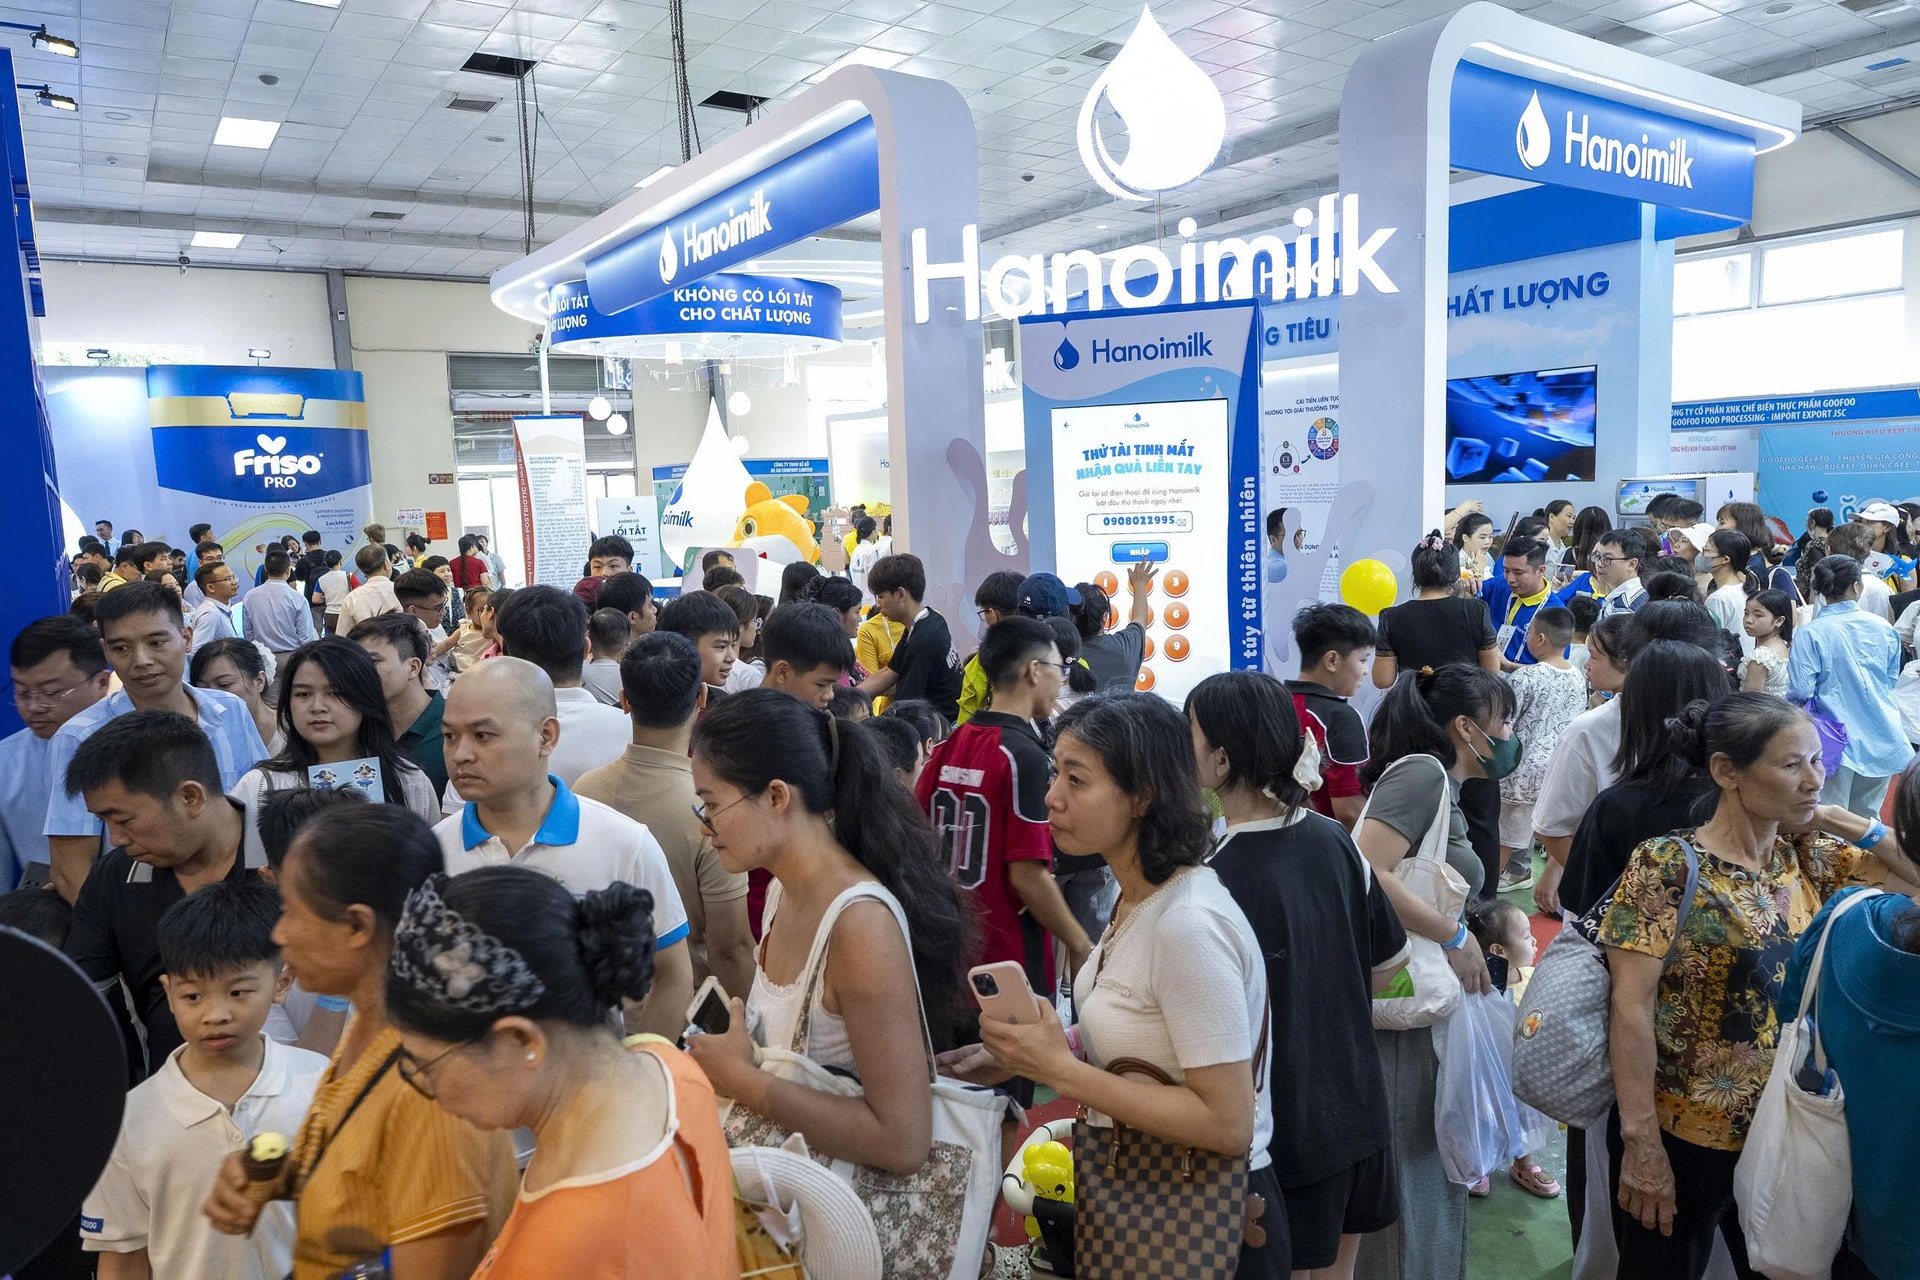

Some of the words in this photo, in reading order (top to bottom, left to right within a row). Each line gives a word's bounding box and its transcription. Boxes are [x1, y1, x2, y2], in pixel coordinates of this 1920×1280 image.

[1565, 111, 1693, 189] Hanoimilk
[684, 189, 772, 267] Hanoimilk
[911, 193, 1400, 324] Hanoimilk
[571, 291, 589, 310] TẮT
[673, 285, 738, 302] KHÔNG
[742, 286, 764, 303] CÓ
[768, 287, 791, 305] LỐI
[794, 289, 814, 308] TẮT
[1447, 287, 1494, 319] HẤT
[1503, 271, 1612, 310] LƯỢNG
[558, 314, 588, 332] LƯỢNG
[680, 307, 717, 321] CHO
[721, 306, 762, 321] CHẤT
[765, 308, 812, 325] LƯỢNG
[1286, 316, 1330, 342] TIÊU
[1092, 332, 1214, 365] Hanoimilk
[1671, 407, 1684, 417] ÔNG
[1685, 408, 1694, 416] TY
[1725, 405, 1741, 414] XNK
[1757, 400, 1775, 411] BIẾN
[1776, 400, 1797, 412] THỰC
[1798, 398, 1821, 410] PHẨM
[1823, 397, 1856, 408] GOOFOO
[1672, 417, 1700, 427] GOOFOO
[1701, 416, 1720, 425] FOOD
[1721, 413, 1765, 424] PROCESSING
[1771, 411, 1801, 421] IMPORT
[1802, 409, 1832, 419] EXPORT
[1832, 408, 1847, 418] JSC
[1083, 443, 1108, 461] THỬ
[1110, 442, 1131, 457] TÀI
[1133, 444, 1164, 456] TINH
[1166, 438, 1195, 457] MẮT
[233, 449, 322, 476] Friso
[1076, 463, 1112, 480] NHẬN
[1114, 459, 1143, 474] QUÀ
[1145, 456, 1174, 474] LIỀN
[1177, 462, 1203, 475] TAY
[264, 476, 297, 489] PRO
[1168, 486, 1200, 494] Hanoimilk
[521, 486, 531, 533] POSTBIOTIC
[1239, 476, 1256, 533] nhiên
[629, 523, 647, 535] TẮT
[1239, 539, 1257, 592] thiên
[1172, 609, 1180, 619] 6
[1173, 641, 1181, 651] 9
